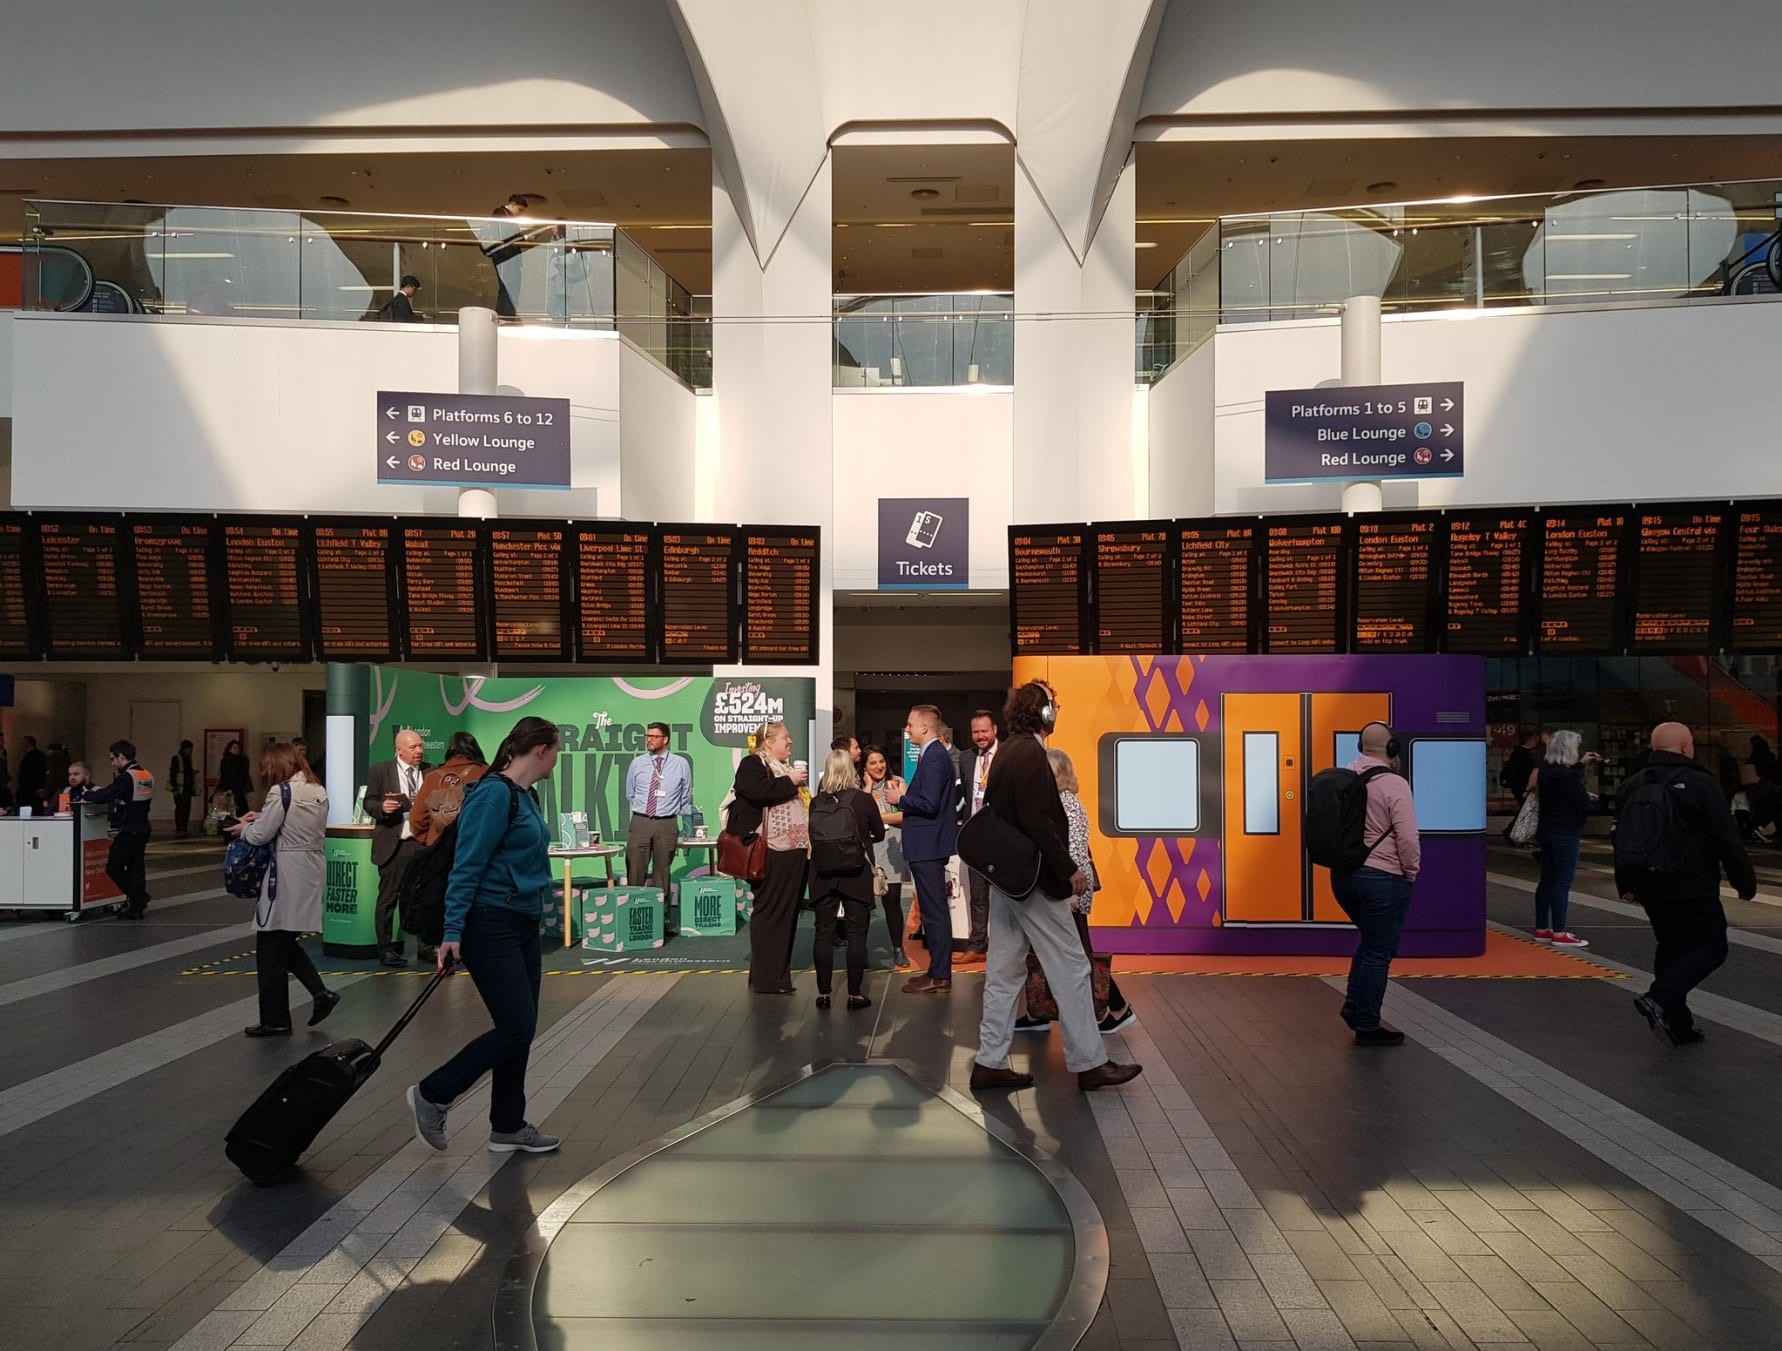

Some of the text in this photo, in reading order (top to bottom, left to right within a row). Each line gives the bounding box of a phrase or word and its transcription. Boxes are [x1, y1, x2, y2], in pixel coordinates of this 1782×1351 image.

[1291, 401, 1407, 419] Platforms 1 to 5
[433, 408, 554, 426] Platforms 6 to 12
[1317, 427, 1406, 442] Blue Lounge
[433, 433, 535, 451] Yellow Lounge
[1321, 453, 1406, 467] Red Lounge
[433, 458, 517, 475] Red Lounge
[1499, 520, 1514, 529] Plat
[1596, 518, 1612, 527] Plat
[1312, 527, 1326, 535] Plat
[1411, 524, 1426, 532] Plat
[1641, 526, 1717, 537] Glasgow Central via
[1739, 525, 1761, 534] Four
[537, 532, 551, 540] Plat
[1141, 533, 1155, 541] Plat
[1227, 529, 1240, 538] Plat
[1450, 533, 1481, 542] Rugeley
[1493, 532, 1517, 541] Valley
[1545, 530, 1607, 539] London Euston
[42, 536, 81, 545] Leicester
[134, 537, 182, 546] Bromsgrove
[226, 537, 285, 546] London Euston
[316, 539, 348, 548] Lichfield
[360, 539, 382, 548] Valley
[405, 540, 429, 548] Walsall
[1057, 536, 1070, 544] Plat
[1269, 538, 1325, 547] Wolverhampton
[1359, 535, 1419, 545] London Euston
[492, 542, 531, 551] Manchester
[534, 542, 548, 551] Picc
[580, 544, 644, 554] Liverpool Lime St
[1098, 545, 1141, 554] Shrewsbury
[1182, 541, 1230, 550] Lichfield City
[663, 546, 700, 555] Edinburgh
[748, 548, 779, 556] Redditch
[1014, 547, 1061, 556] Bournemouth
[896, 561, 953, 576] Tickets
[725, 681, 762, 698] Investing
[593, 711, 614, 730] The
[714, 715, 784, 723] ON STRAIGHT-UP
[326, 861, 358, 888] DIRECT
[326, 888, 358, 903] FASTER
[326, 903, 358, 914] MORE
[694, 896, 722, 917] MORE
[629, 907, 654, 926] FASTER
